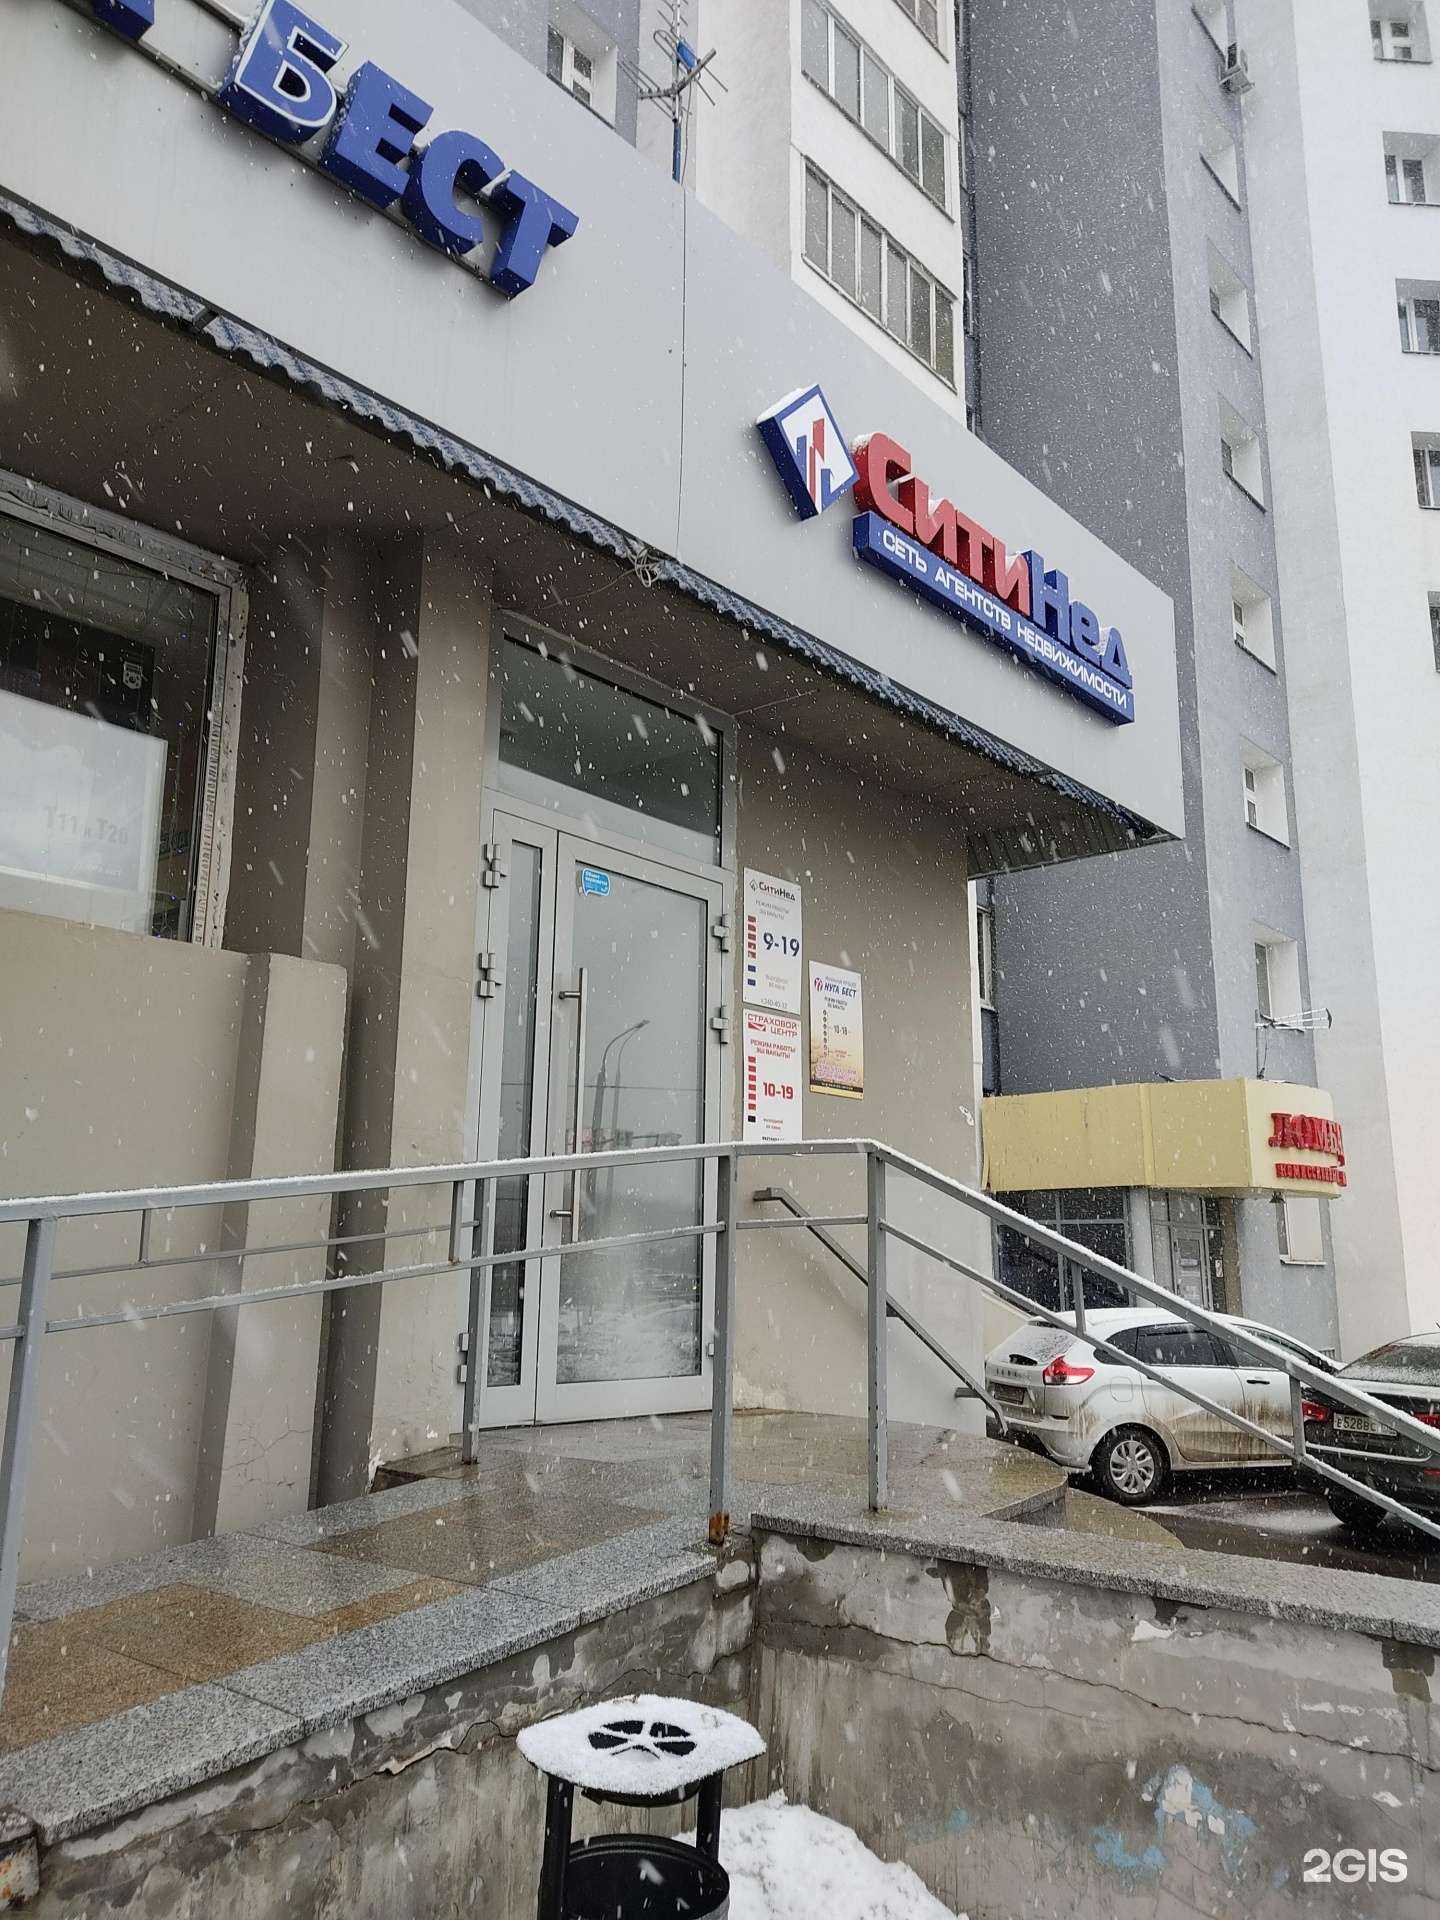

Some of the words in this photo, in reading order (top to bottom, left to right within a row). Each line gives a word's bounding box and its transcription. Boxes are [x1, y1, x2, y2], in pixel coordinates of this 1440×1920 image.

[222, 0, 579, 298] БЕСТ
[852, 431, 1133, 690] СитиНед
[882, 529, 928, 574] СЕТЬ
[935, 566, 1011, 631] АГЕНТСТВ
[1017, 621, 1127, 709] НЕДВИЖИМОСТИ
[763, 932, 800, 957] 9-19
[824, 982, 840, 995] НУГА
[841, 985, 857, 999] БЕСТ
[747, 1013, 798, 1031] СТРАХОВОЙ
[770, 1026, 798, 1039] ЦЕНТР
[762, 1082, 794, 1100] 10-19
